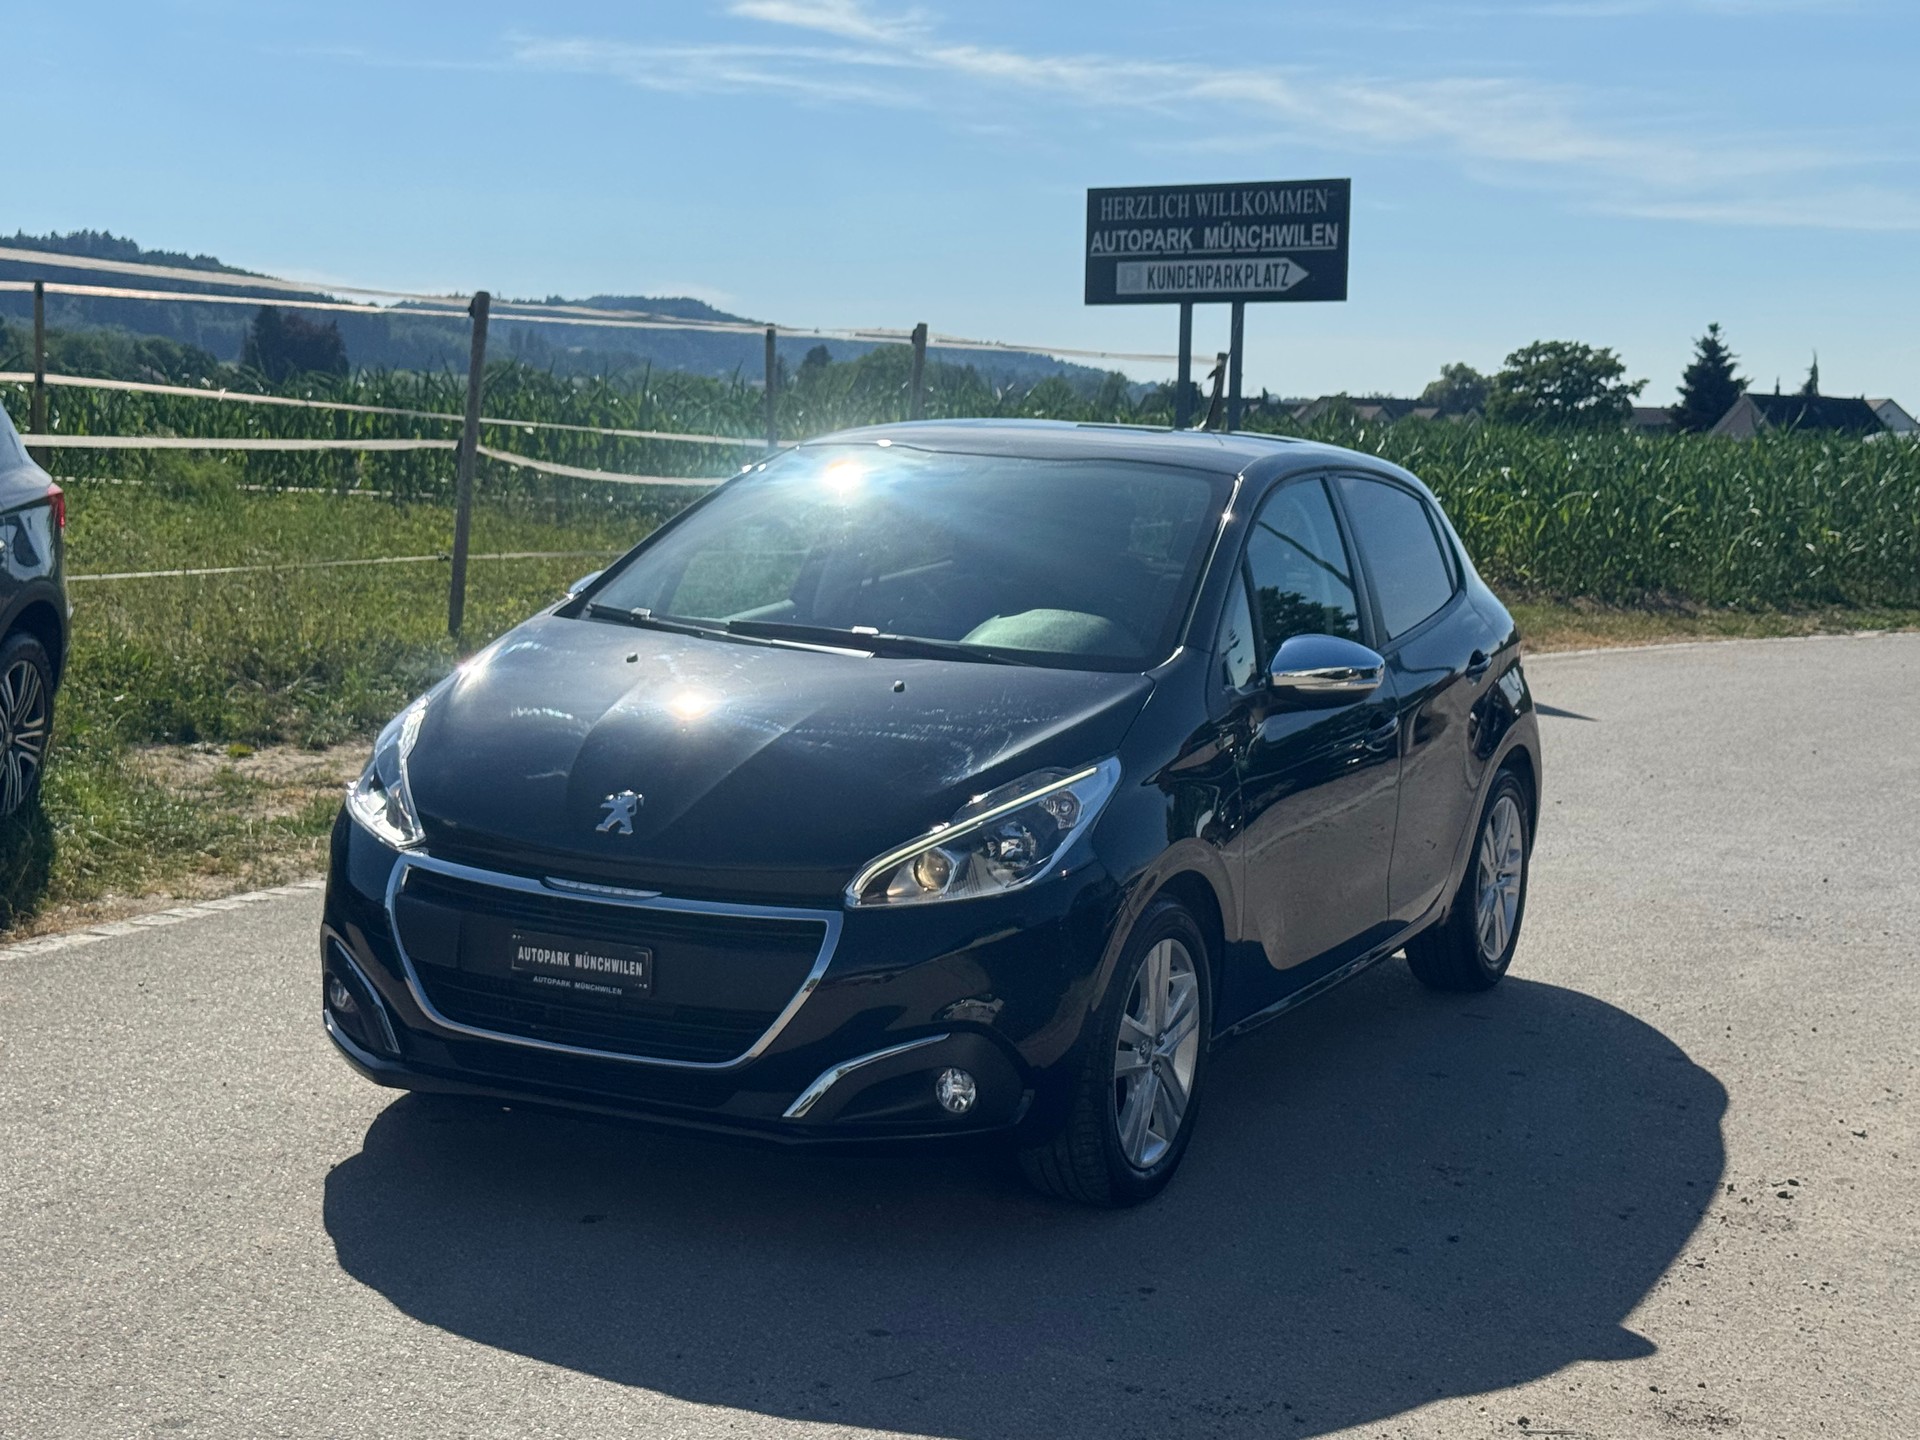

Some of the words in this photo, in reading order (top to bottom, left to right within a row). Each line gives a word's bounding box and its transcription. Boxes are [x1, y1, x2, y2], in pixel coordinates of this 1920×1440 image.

[1100, 194, 1190, 221] HERZLICH
[1195, 189, 1329, 218] WILLKOMMEN
[1090, 227, 1194, 252] AUTOPARK
[1204, 221, 1339, 249] MÜNCHWILEN
[1147, 263, 1290, 290] KUNDENPARKPLATZ
[518, 946, 570, 966] AUTOPARK
[575, 952, 643, 976] MÜNCHWILEN
[533, 976, 571, 987] AUTOPARK
[575, 981, 622, 995] MÜNCHWILEN
